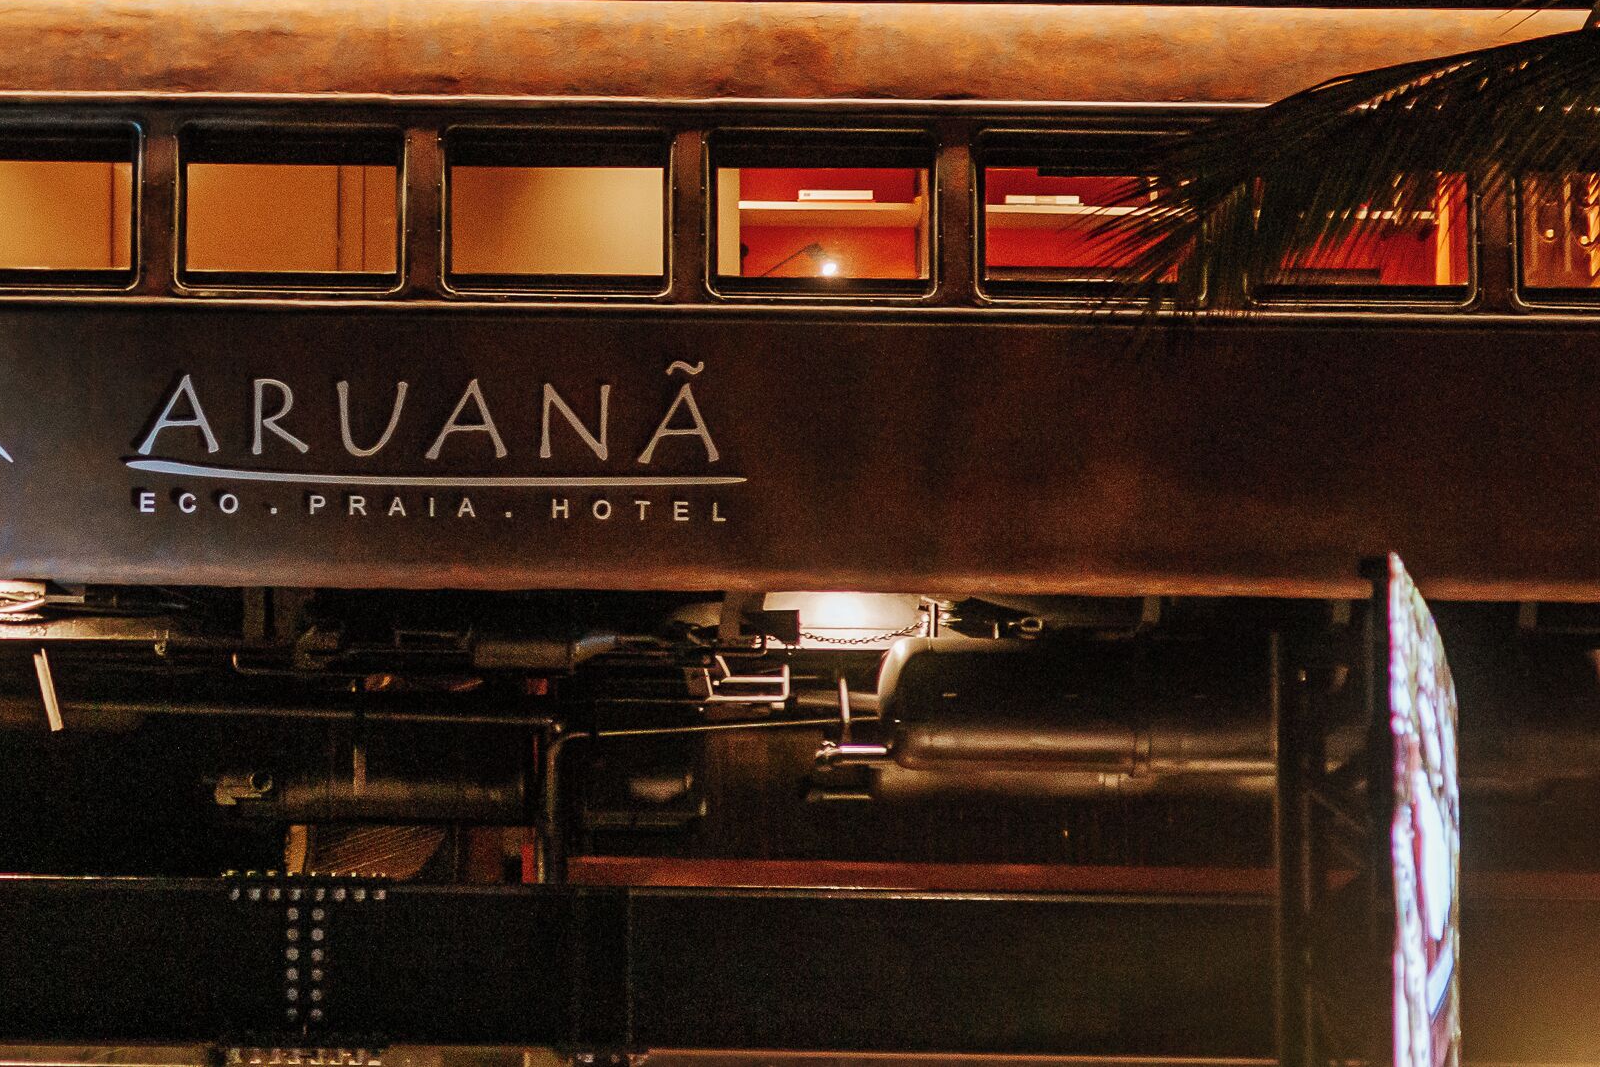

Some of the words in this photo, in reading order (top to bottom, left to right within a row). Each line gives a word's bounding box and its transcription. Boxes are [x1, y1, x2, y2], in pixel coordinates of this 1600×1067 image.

[137, 360, 720, 464] ARUANÃ
[139, 491, 240, 514] ECO
[309, 494, 477, 518] PRAIA
[551, 497, 728, 522] HOTEL
